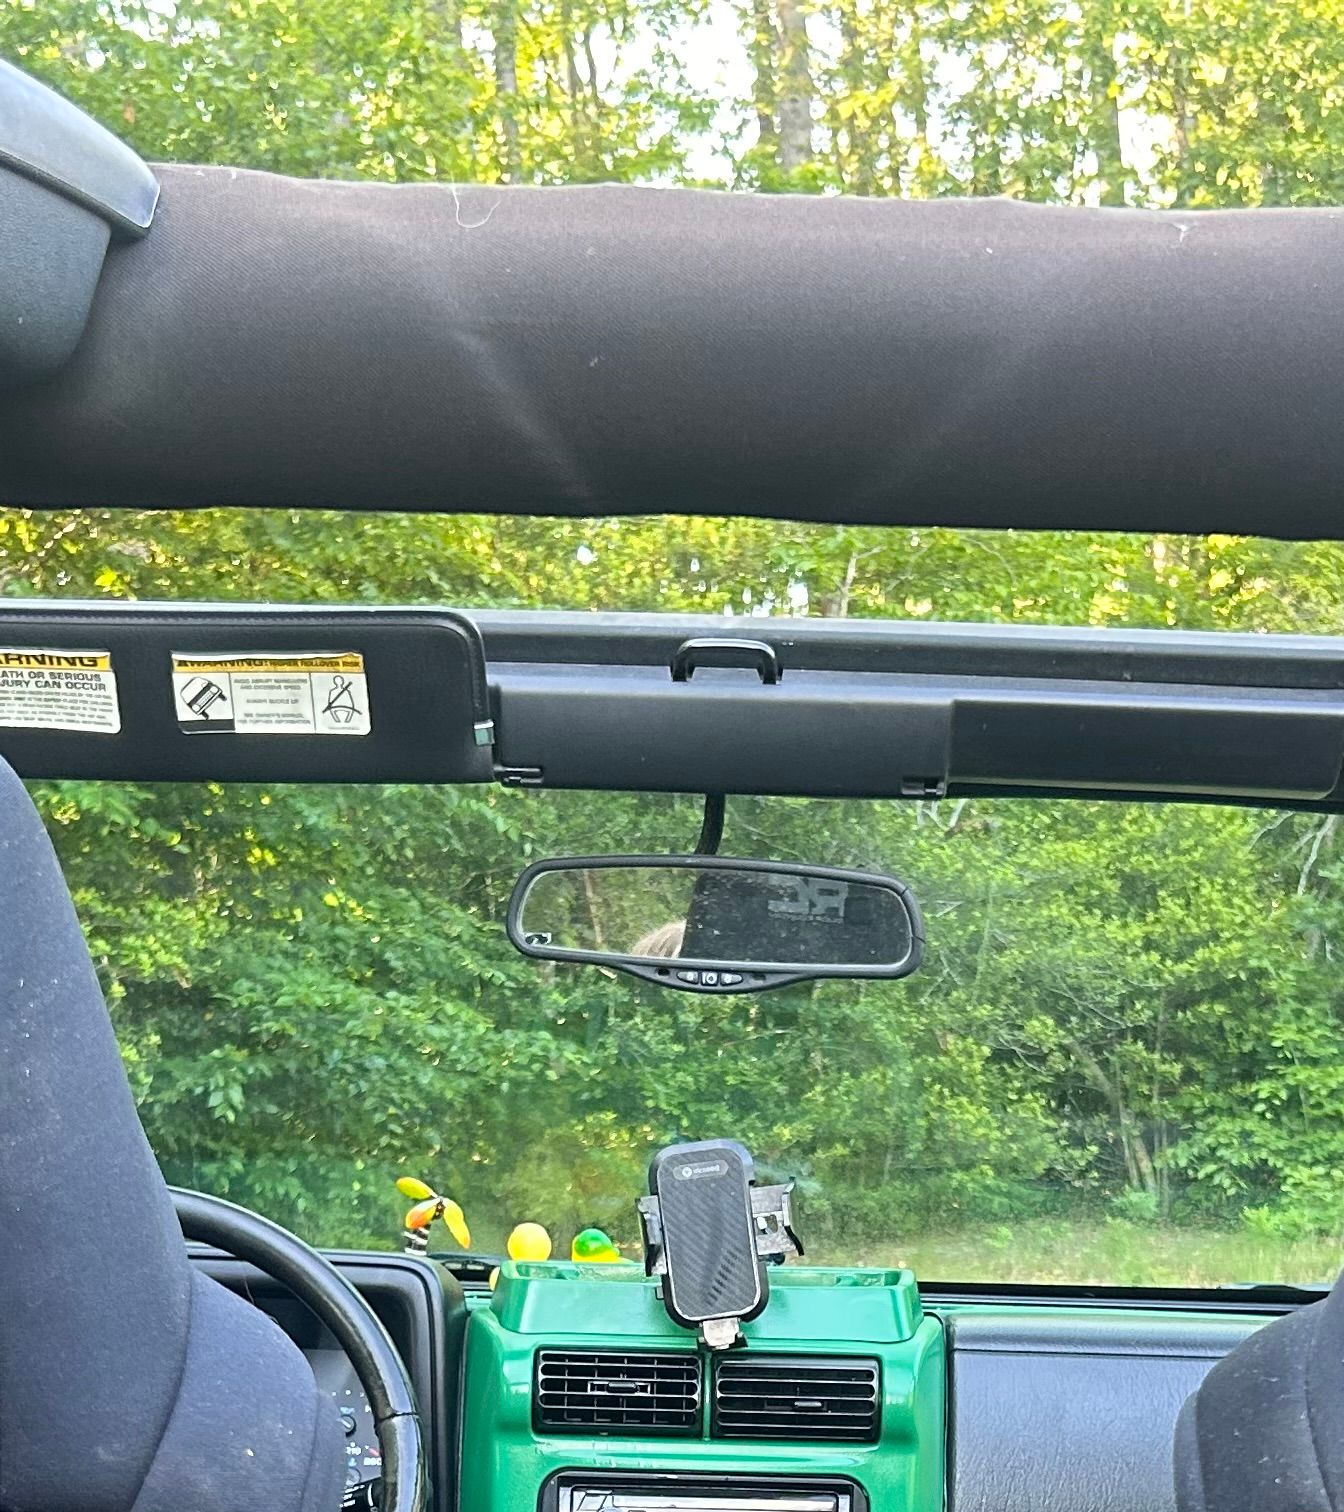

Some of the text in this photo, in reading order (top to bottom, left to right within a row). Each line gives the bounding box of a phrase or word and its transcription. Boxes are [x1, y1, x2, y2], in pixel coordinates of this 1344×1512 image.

[28, 671, 45, 679] OR
[49, 672, 102, 682] SERIOUS
[35, 680, 61, 689] CAN
[65, 682, 107, 691] OCCUR
